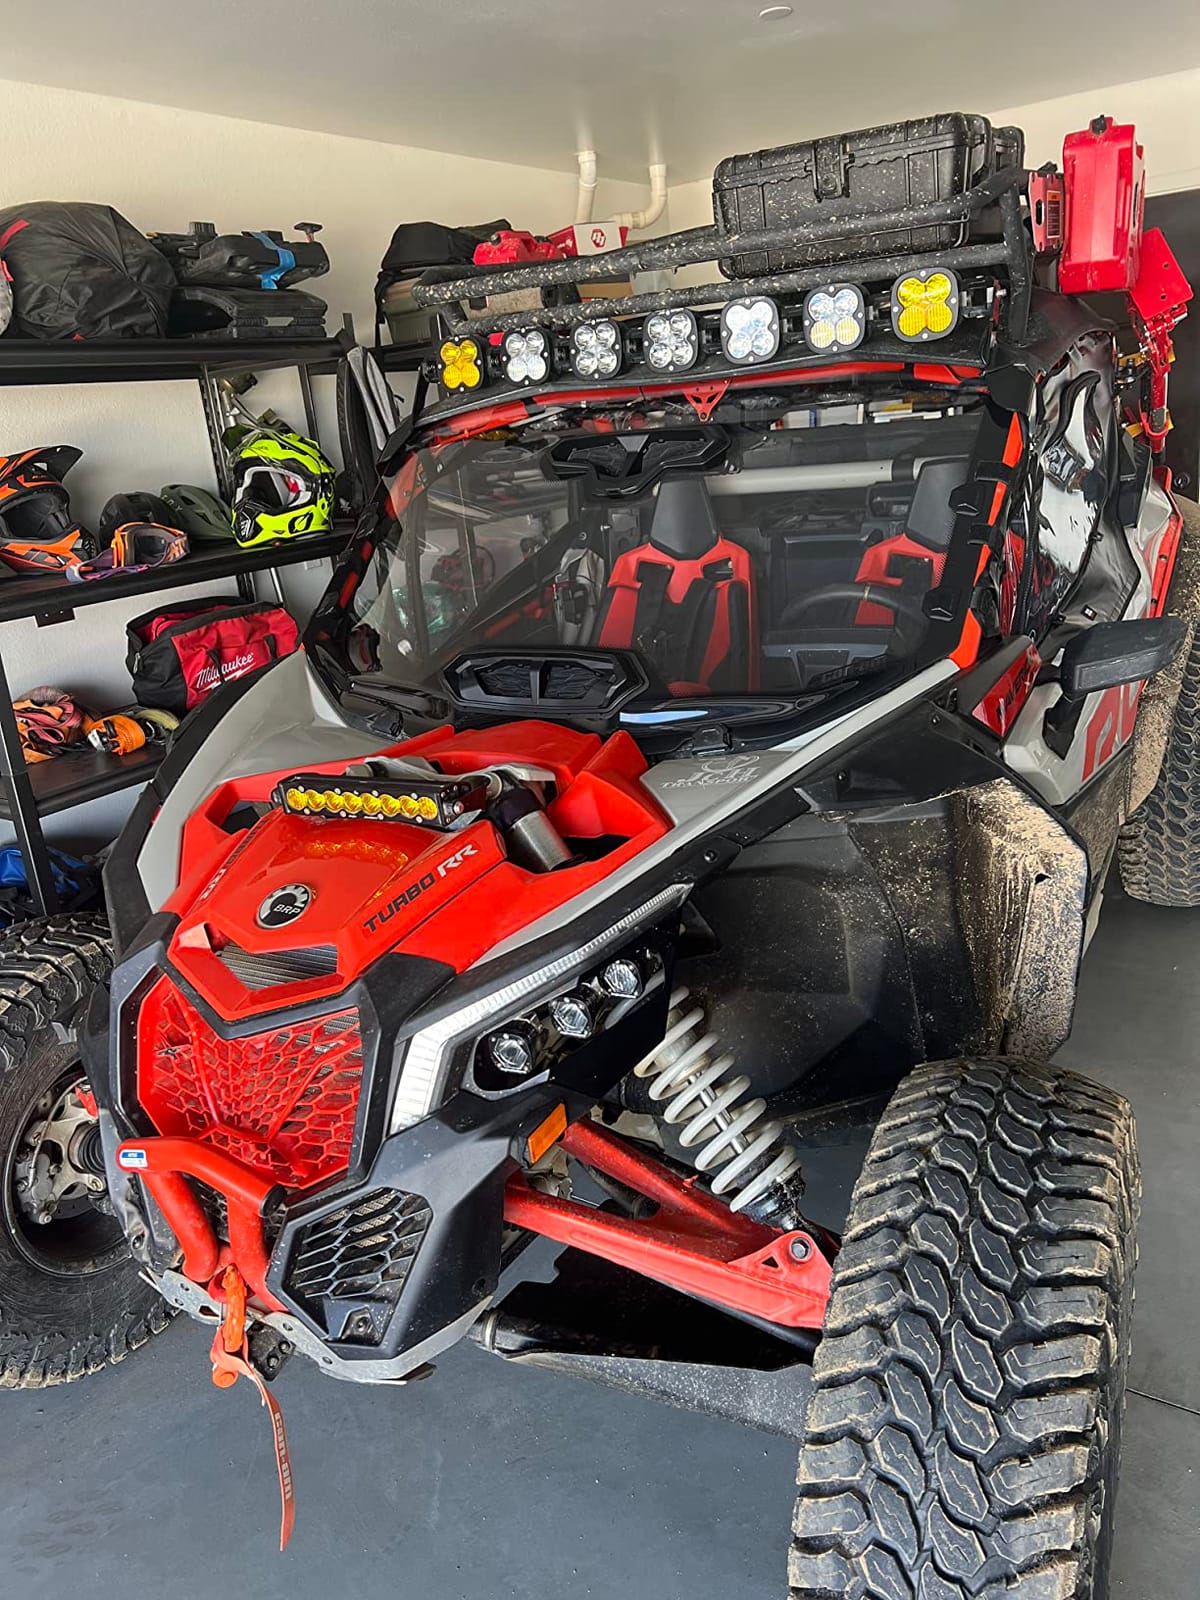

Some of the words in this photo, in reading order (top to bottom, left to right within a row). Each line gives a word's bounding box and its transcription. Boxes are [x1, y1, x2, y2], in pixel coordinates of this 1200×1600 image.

[273, 903, 302, 915] BRP
[363, 872, 436, 933] TURBO
[437, 844, 479, 878] RR
